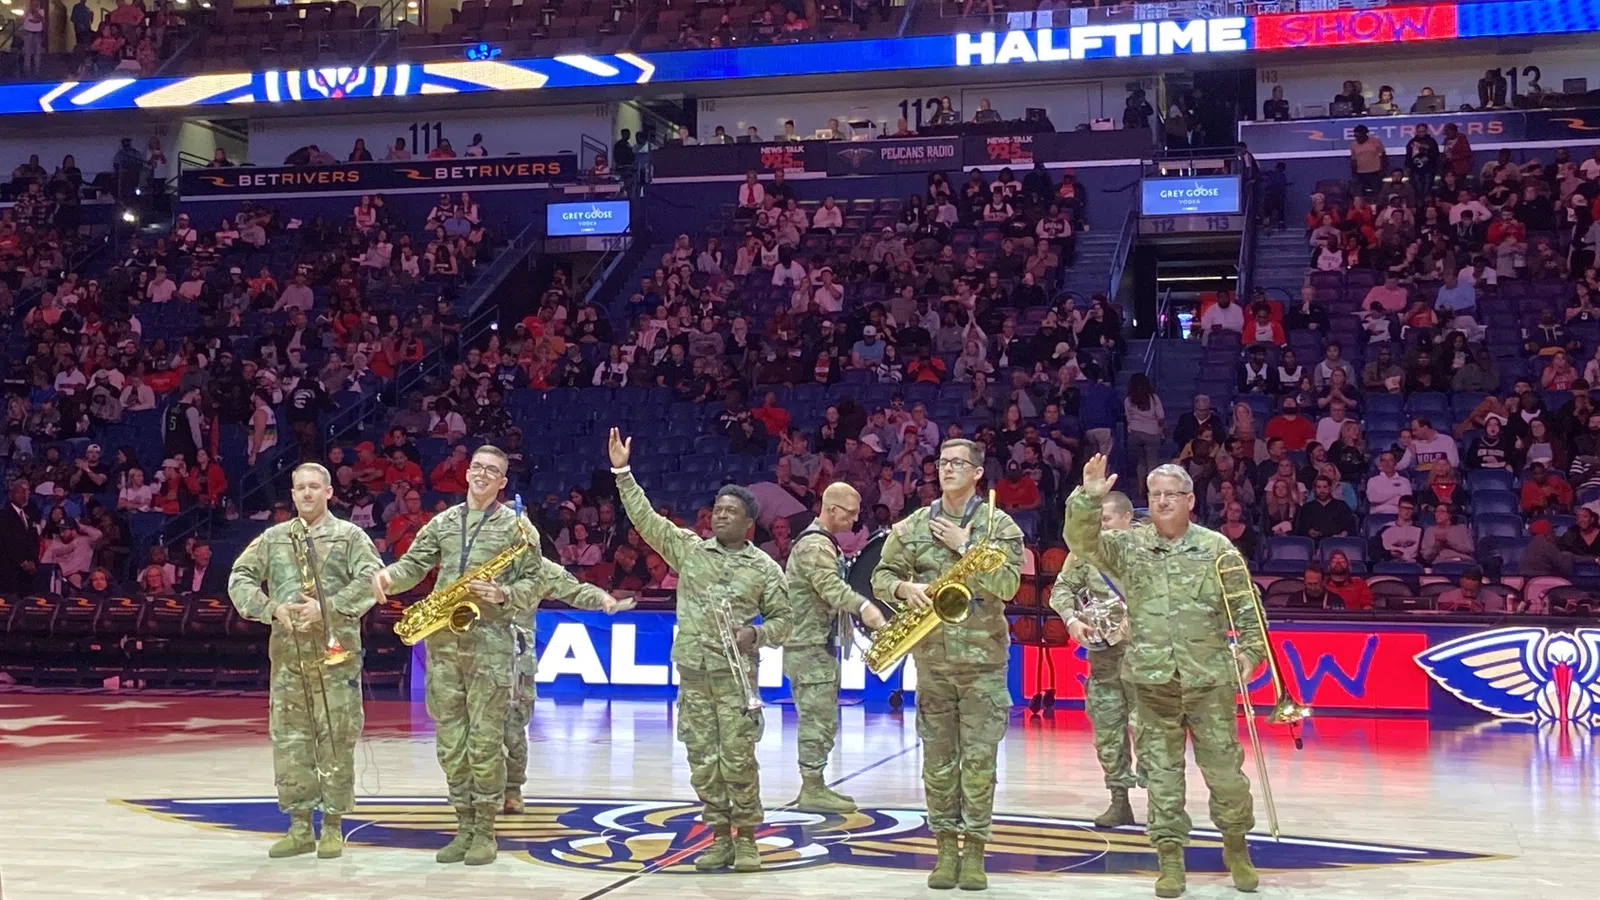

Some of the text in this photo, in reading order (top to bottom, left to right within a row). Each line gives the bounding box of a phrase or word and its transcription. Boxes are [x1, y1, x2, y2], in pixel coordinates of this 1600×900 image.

[955, 5, 1435, 65] HALFTIME SHOW
[1494, 65, 1541, 101] 13
[898, 98, 942, 132] 112
[409, 122, 442, 155] 111
[1343, 121, 1503, 141] BTRVRS
[880, 144, 954, 160] PELICANS RADIO
[238, 170, 360, 187] BETRIVERS
[434, 162, 561, 180] BETRIVERS
[1160, 187, 1219, 198] GREY GOOSE
[562, 210, 613, 220] GREY GOOSE
[1152, 217, 1230, 232] 112 113
